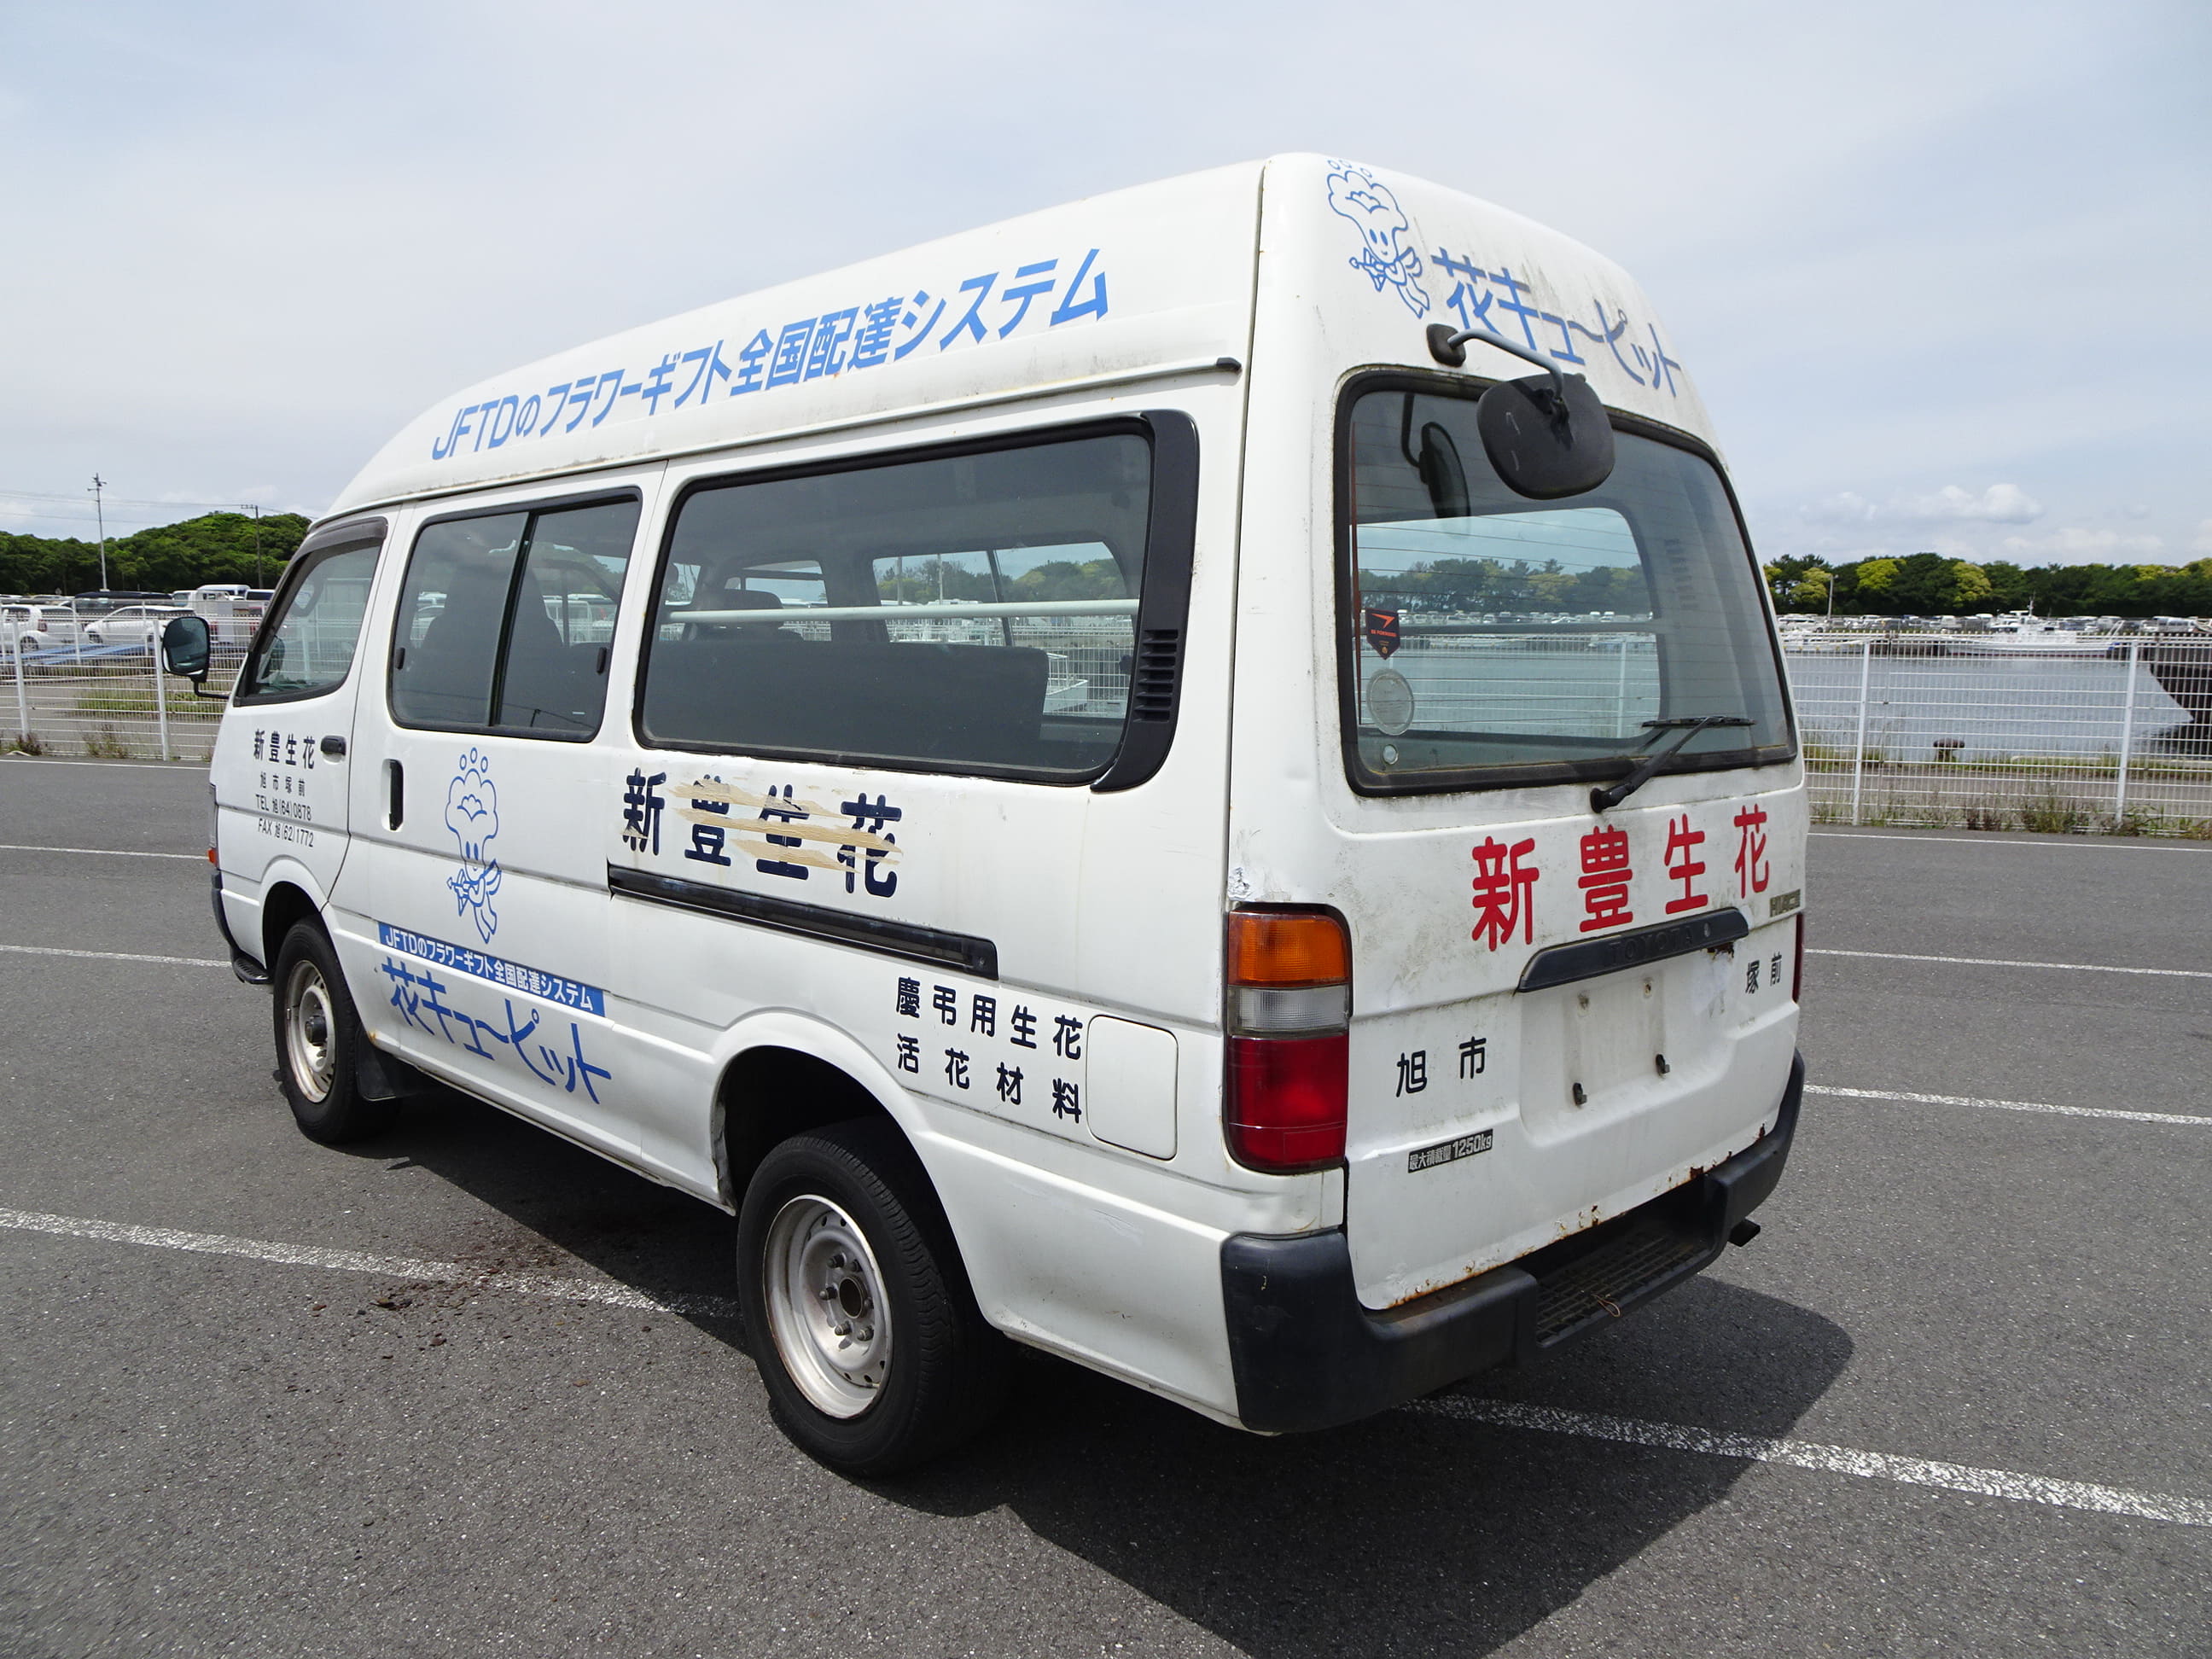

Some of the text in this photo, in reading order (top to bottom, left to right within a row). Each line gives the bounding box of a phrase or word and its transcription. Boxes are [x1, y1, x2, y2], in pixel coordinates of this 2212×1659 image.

[432, 248, 1109, 460] JFTDのフラワーギフト全国配達システム
[1430, 247, 1681, 397] 花キューピット
[255, 794, 269, 812] TEL
[258, 818, 272, 835] FAX
[622, 768, 903, 898] 新豊生花
[1471, 804, 1770, 952] 新豊生花
[385, 927, 594, 1011] JFTDのフラワーギフト全国配達システム
[1608, 925, 1694, 965] TOYOTA
[381, 957, 612, 1104] 花キューピット
[896, 976, 1084, 1061] 慶弔用生花
[897, 1033, 1082, 1123] 活花材料
[1396, 1036, 1487, 1097] 旭市
[1452, 1133, 1492, 1159] 1250kg
